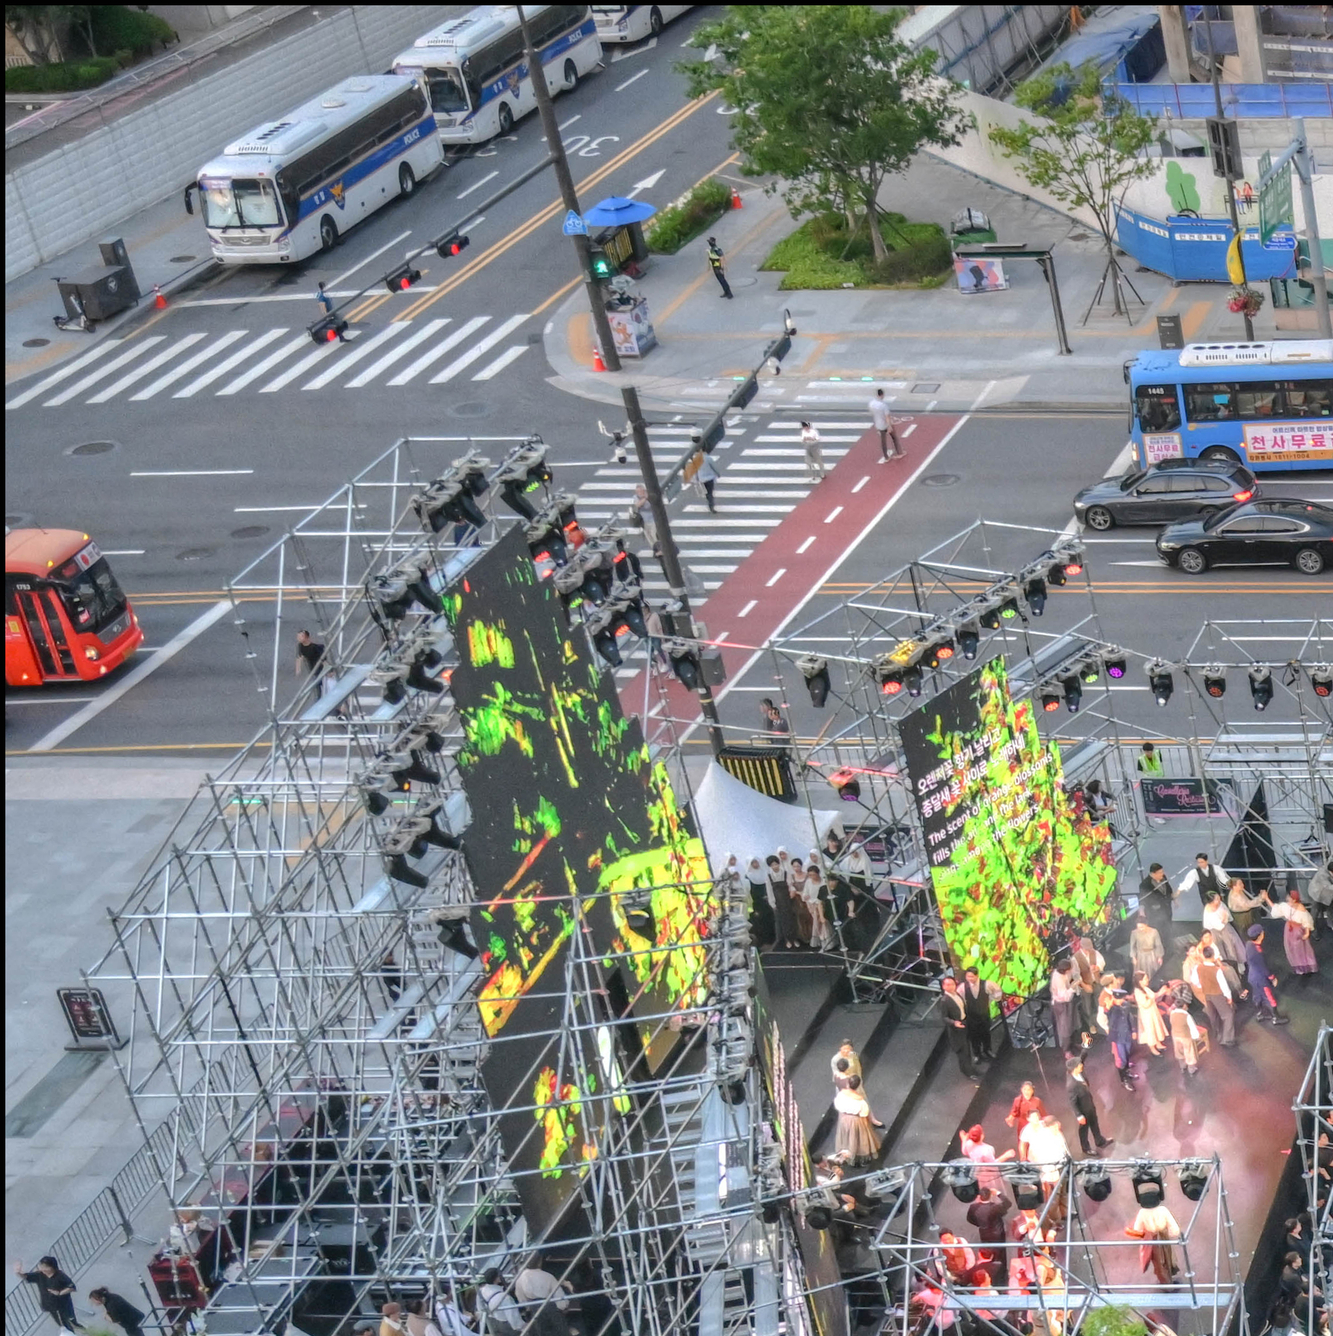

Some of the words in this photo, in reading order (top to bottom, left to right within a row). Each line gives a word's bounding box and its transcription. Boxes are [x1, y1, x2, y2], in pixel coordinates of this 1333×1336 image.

[403, 129, 420, 145] POLICE
[917, 758, 955, 796] 오렌지꽃
[953, 749, 974, 770] 향기
[973, 728, 1002, 758] 날리고
[962, 760, 989, 785] 사이로
[928, 828, 948, 847] The
[947, 811, 972, 835] scent
[1014, 752, 1053, 786] blossoms
[991, 828, 1007, 844] the
[1007, 802, 1039, 828] flowers
[932, 845, 951, 866] fills
[999, 799, 1014, 816] the
